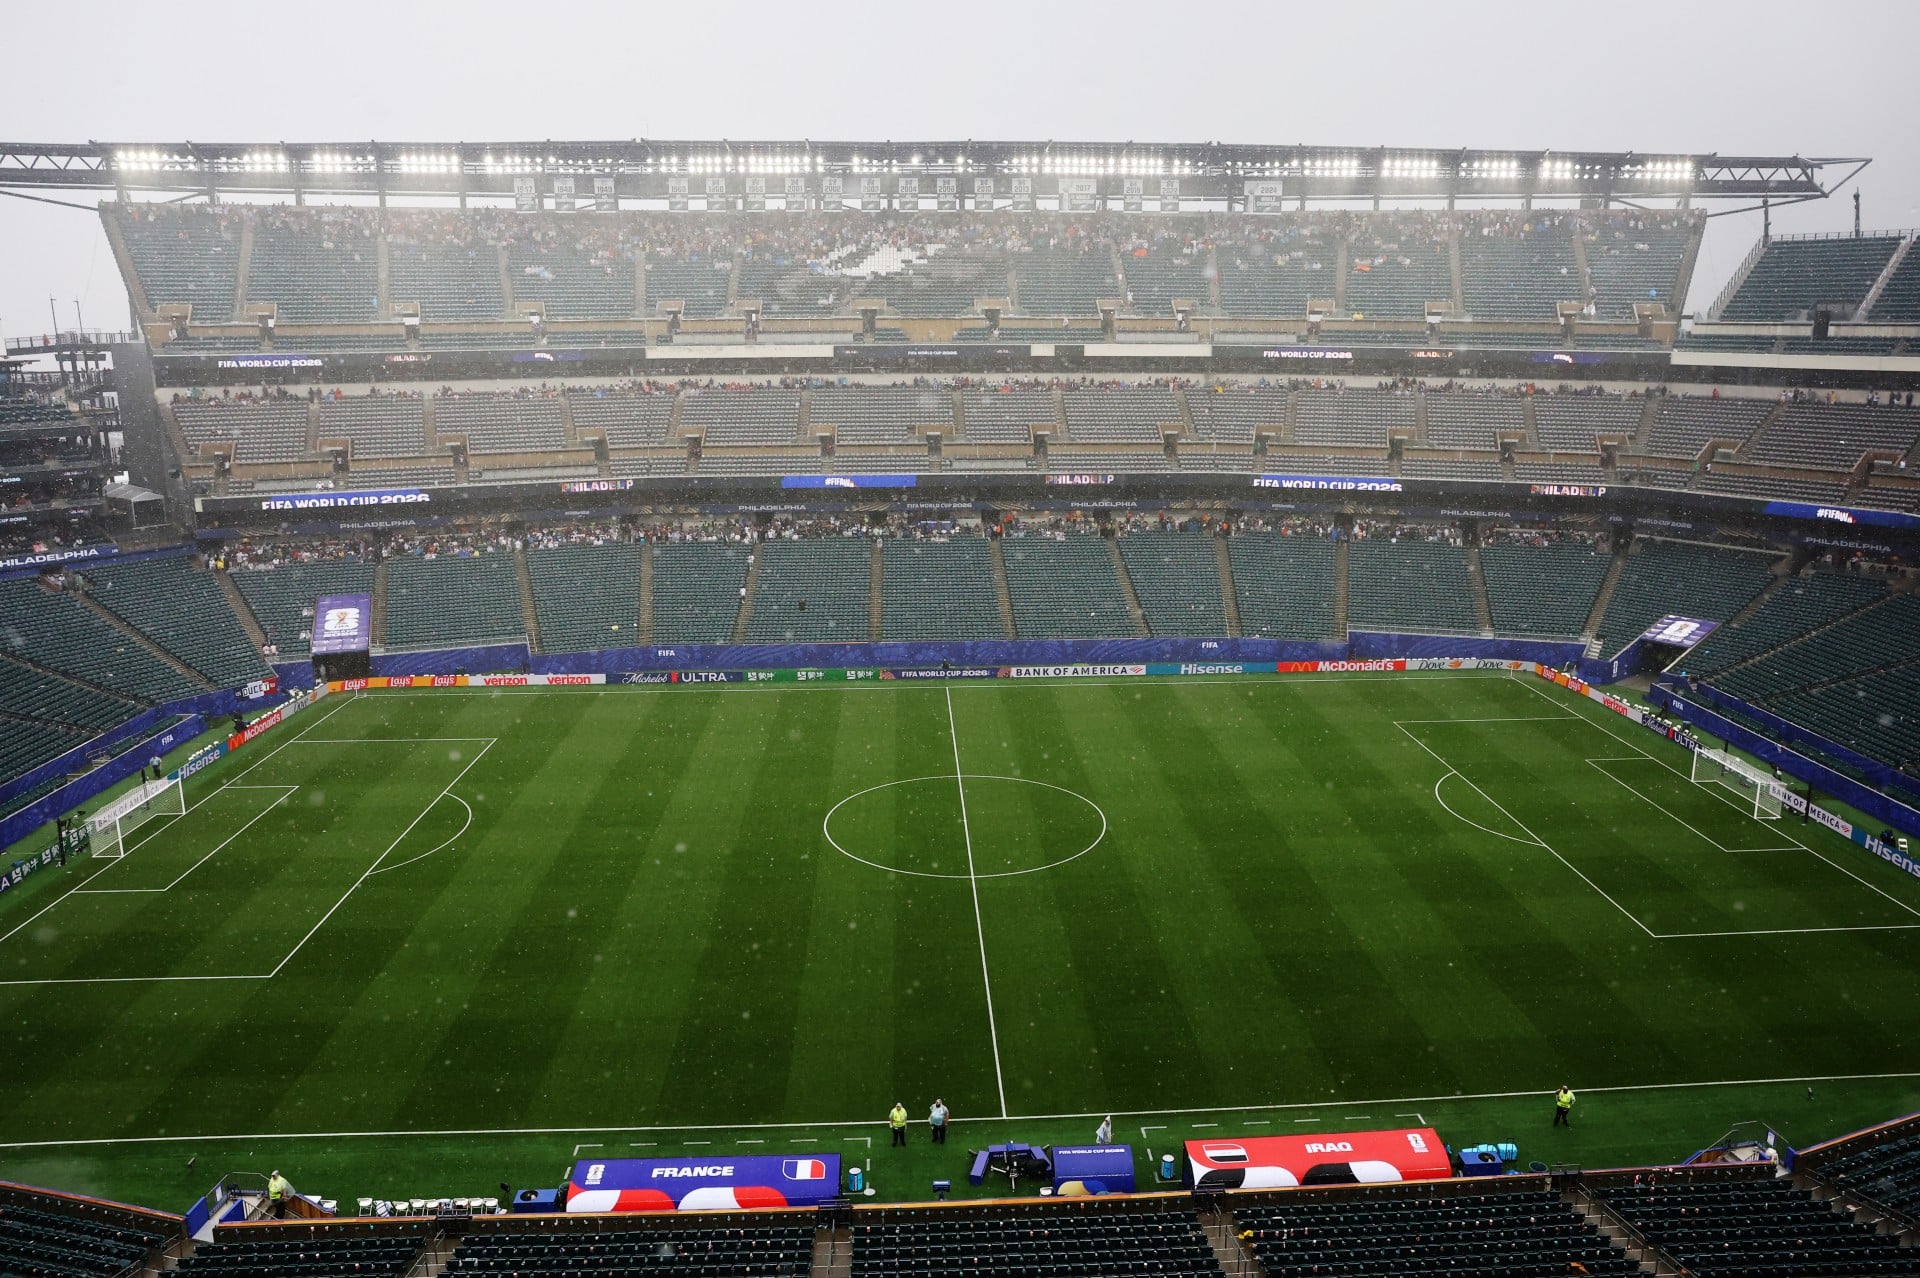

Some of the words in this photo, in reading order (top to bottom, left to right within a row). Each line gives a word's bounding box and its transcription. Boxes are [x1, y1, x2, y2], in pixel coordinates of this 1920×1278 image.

[1260, 186, 1277, 194] 2024
[1263, 350, 1280, 358] FIFA
[1308, 351, 1325, 359] CUP
[1325, 351, 1353, 359] 2026
[218, 359, 238, 368] FIFA
[238, 359, 272, 368] WORLD
[271, 359, 291, 368] CUP
[291, 358, 323, 368] 2026
[1253, 478, 1279, 487] FIFA
[1281, 480, 1327, 489] WORLD
[1329, 481, 1356, 490] CUP
[1357, 482, 1403, 492] 2026
[261, 500, 292, 510] FIFA
[295, 497, 348, 509] WORLD
[350, 496, 379, 506] CUP
[380, 493, 430, 504] 2026
[1440, 509, 1512, 518] PHILADELPHIA
[339, 519, 416, 529] PHILADELPHIA
[1805, 536, 1892, 552] PHILADELPHIA
[0, 548, 99, 568] HILADELPHIA
[1201, 641, 1219, 649] FIFA
[657, 649, 676, 657] FIFA
[1181, 663, 1243, 675] Hisense
[1317, 660, 1394, 672] McDonald's
[1418, 661, 1445, 671] Dove
[1475, 660, 1504, 670] Dove
[681, 672, 727, 682] ULTRA
[901, 670, 918, 678] FIFA
[1016, 667, 1050, 677] BANK
[1053, 667, 1069, 676] OF
[1071, 666, 1128, 676] AMERICA
[390, 676, 411, 687] Lay's
[434, 676, 455, 687] Lay's
[484, 675, 528, 686] verizon
[546, 674, 591, 685] verizon
[622, 672, 668, 684] Michelob
[344, 678, 366, 691] Lay's
[1602, 697, 1628, 717] verizon
[1672, 700, 1684, 711] FIFA
[244, 713, 281, 742] McDonald's
[161, 734, 174, 746] FIFA
[178, 749, 221, 779] Hisense
[1771, 786, 1792, 803] BANK
[1793, 798, 1804, 809] OF
[1808, 805, 1840, 830] MERICA
[1304, 1141, 1354, 1154] IRAQ
[651, 1165, 735, 1178] FRANCE
